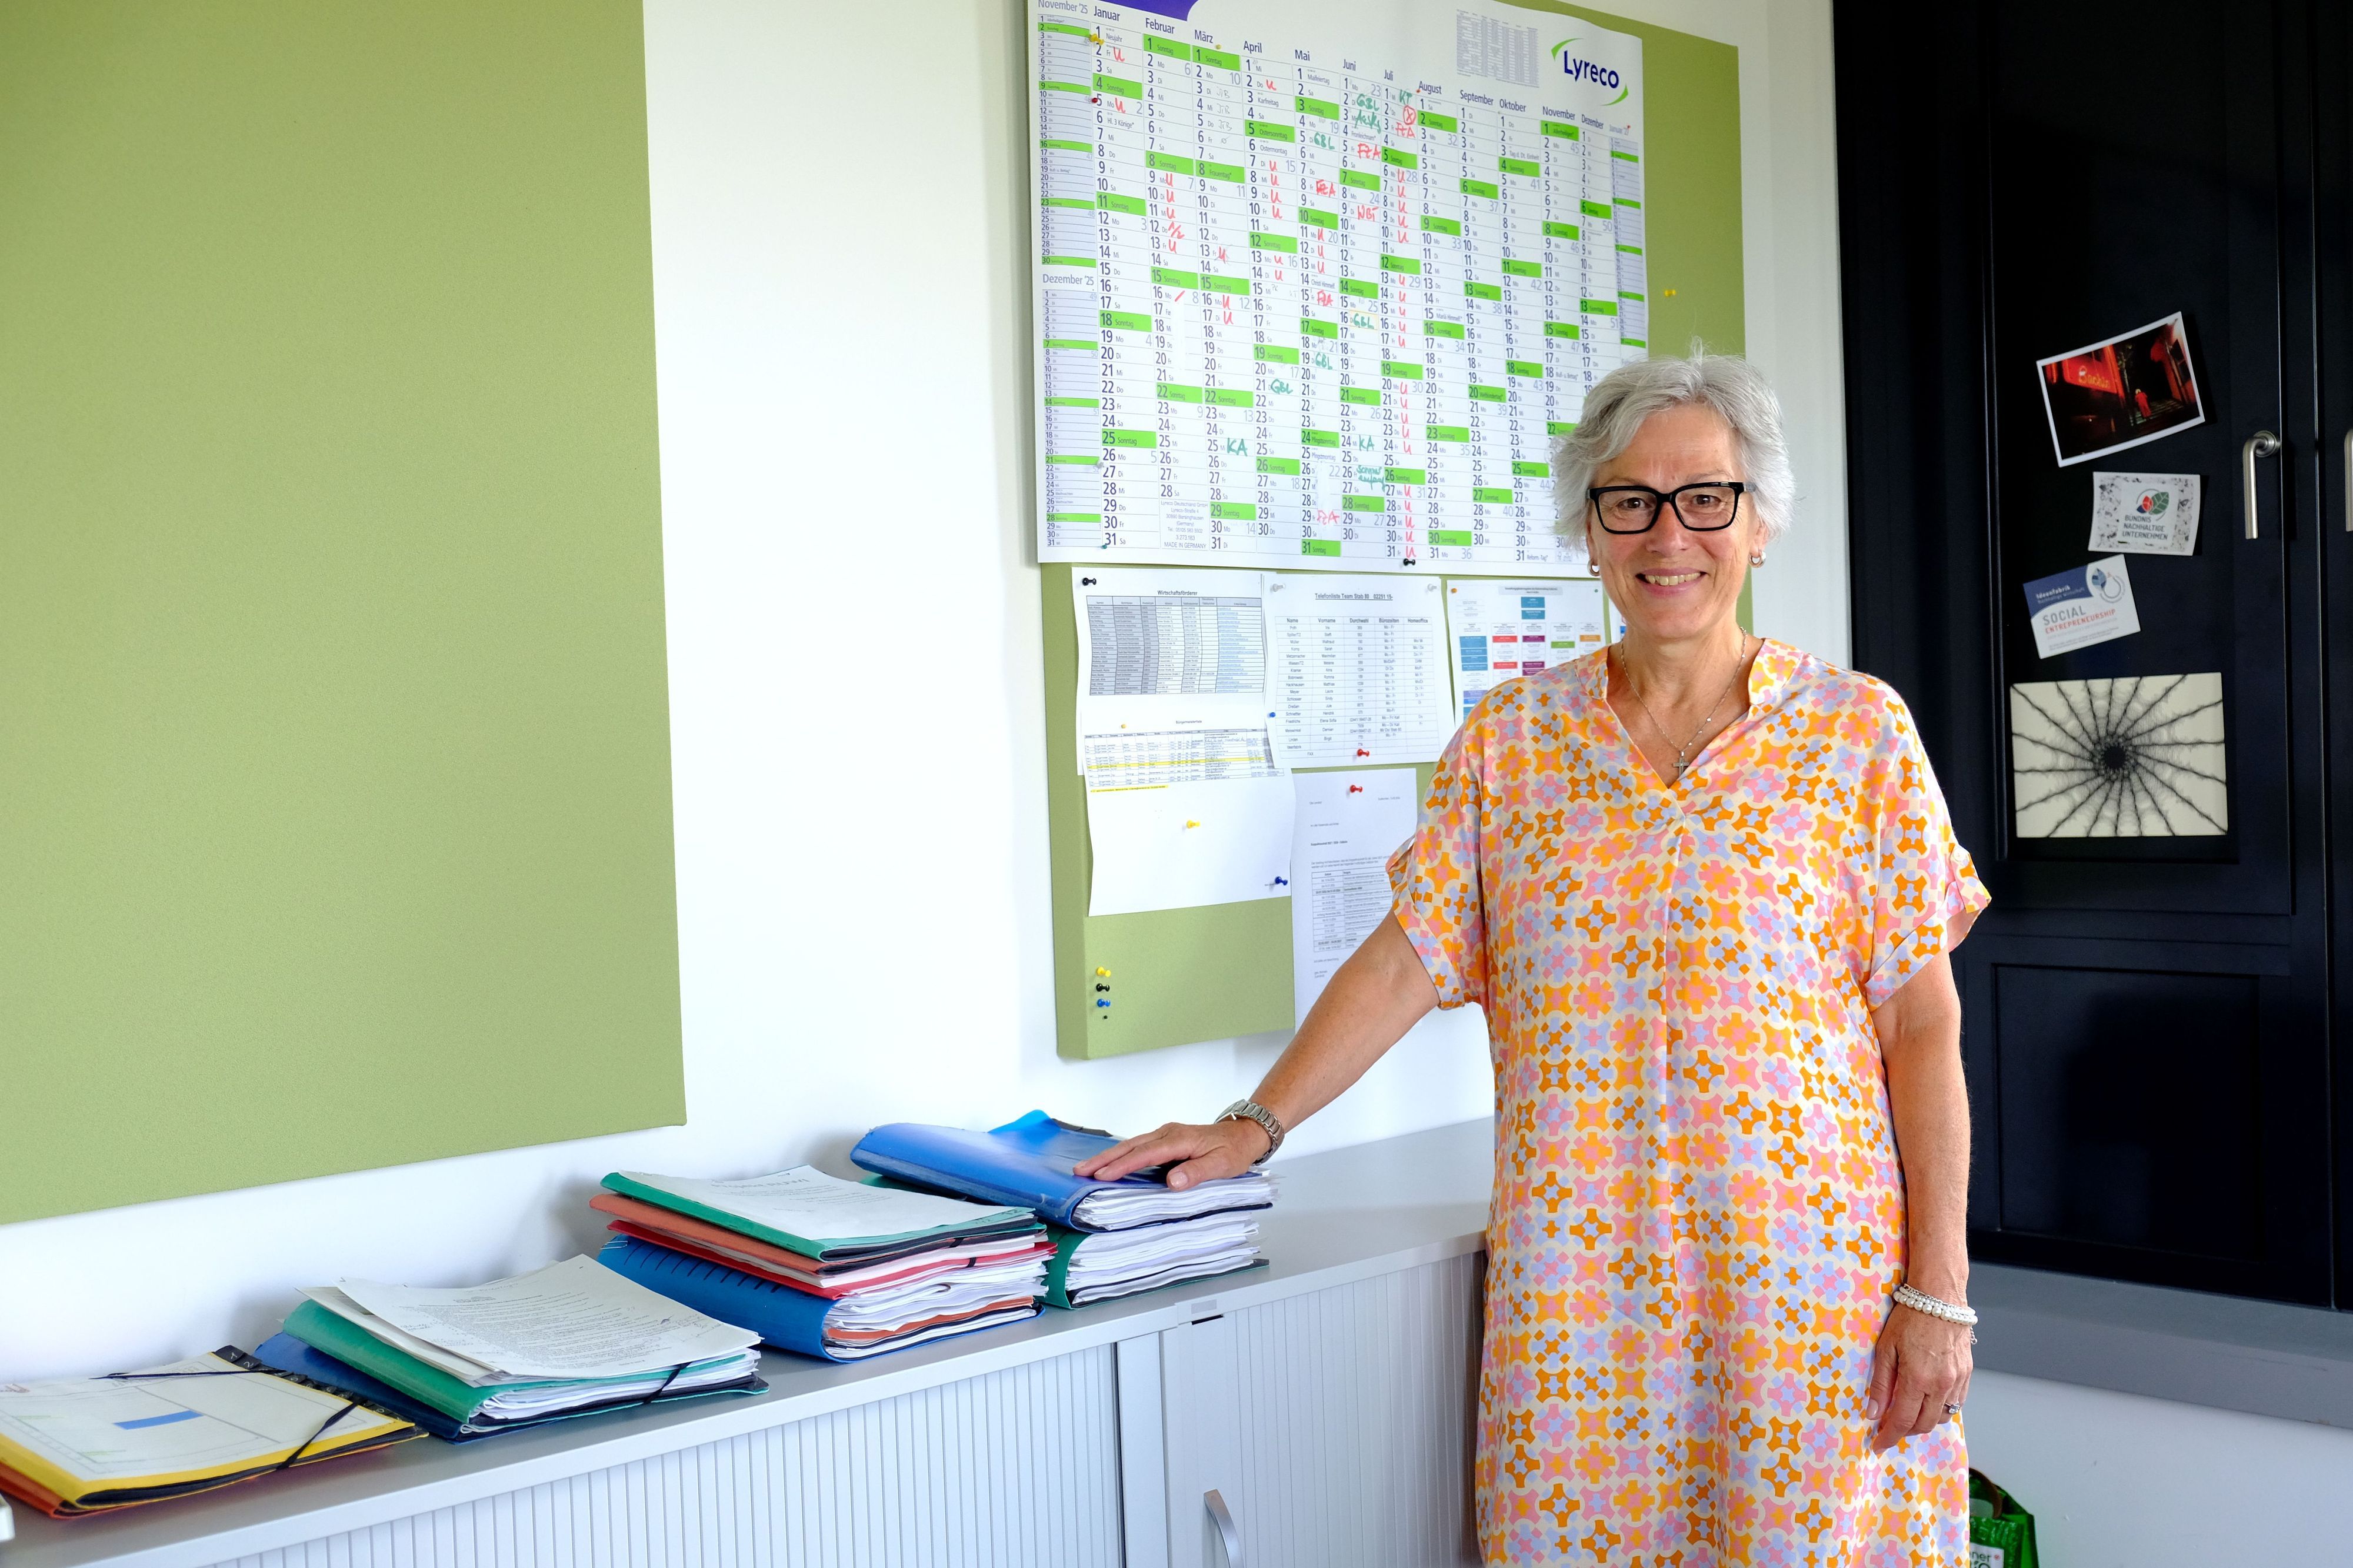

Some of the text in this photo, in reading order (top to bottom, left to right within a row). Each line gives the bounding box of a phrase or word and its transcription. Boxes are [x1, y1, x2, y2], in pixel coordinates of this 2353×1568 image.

[1038, 0, 1078, 12] November
[1094, 6, 1120, 21] Januar
[1145, 18, 1175, 34] Februar
[1106, 33, 1122, 42] Neujahr
[1195, 29, 1213, 44] März
[1148, 38, 1174, 55] 1 Sonntag
[1244, 41, 1262, 54] April
[1148, 54, 1153, 66] 2
[1196, 49, 1222, 66] 1 Sonntag
[1295, 49, 1310, 61] Mai
[1343, 59, 1356, 71] Juni
[1564, 50, 1619, 89] Lyreco
[1229, 72, 1241, 85] 10
[1298, 68, 1330, 85] 1 Maifeiertag
[1384, 69, 1394, 81] Juli
[1096, 76, 1124, 95] 4 Sonntag
[1371, 84, 1381, 97] 23
[1419, 81, 1442, 95] August
[1248, 91, 1279, 107] 3 Karfreitag
[1460, 89, 1494, 106] September
[1499, 99, 1527, 112] Oktober
[1096, 111, 1102, 124] 6
[1542, 106, 1575, 121] November
[1331, 122, 1339, 134] 19
[1581, 114, 1604, 129] Dezember
[1249, 123, 1288, 139] 5 Ostersonntag
[1447, 134, 1458, 145] 32
[1249, 139, 1288, 156] 6 Ostermontag
[1501, 145, 1506, 156] 3
[1571, 143, 1579, 154] 45
[1149, 154, 1176, 171] 8 Sonntag
[1098, 195, 1129, 212] 11 Sonntag
[1602, 221, 1613, 232] 50
[1452, 237, 1462, 249] 33
[1042, 273, 1094, 286] Dezember '25
[1531, 279, 1542, 291] 42
[1239, 298, 1250, 309] 12
[1581, 301, 1588, 312] 13
[1101, 313, 1134, 328] 18 Sonntag
[1469, 386, 1478, 398] 20
[1534, 380, 1544, 391] 43
[1102, 415, 1116, 428] 24
[1102, 432, 1137, 446] 25 Sonntag
[1227, 438, 1248, 456] KA
[1257, 459, 1285, 472] 26 Sonntag
[1342, 497, 1369, 511] 28 Sonntag
[2125, 515, 2151, 523] BÜNDNIS
[2124, 523, 2165, 532] NACHHALTIGE
[1105, 533, 1116, 546] 31
[1429, 532, 1457, 545] 30 Sonntag
[2122, 531, 2168, 540] UNTERNEHMEN
[1461, 548, 1472, 559] 36
[2036, 585, 2071, 599] Ideenfabrik
[2044, 605, 2086, 625] SOCIAL
[2045, 609, 2116, 634] ENTREPRENEURSHIP
